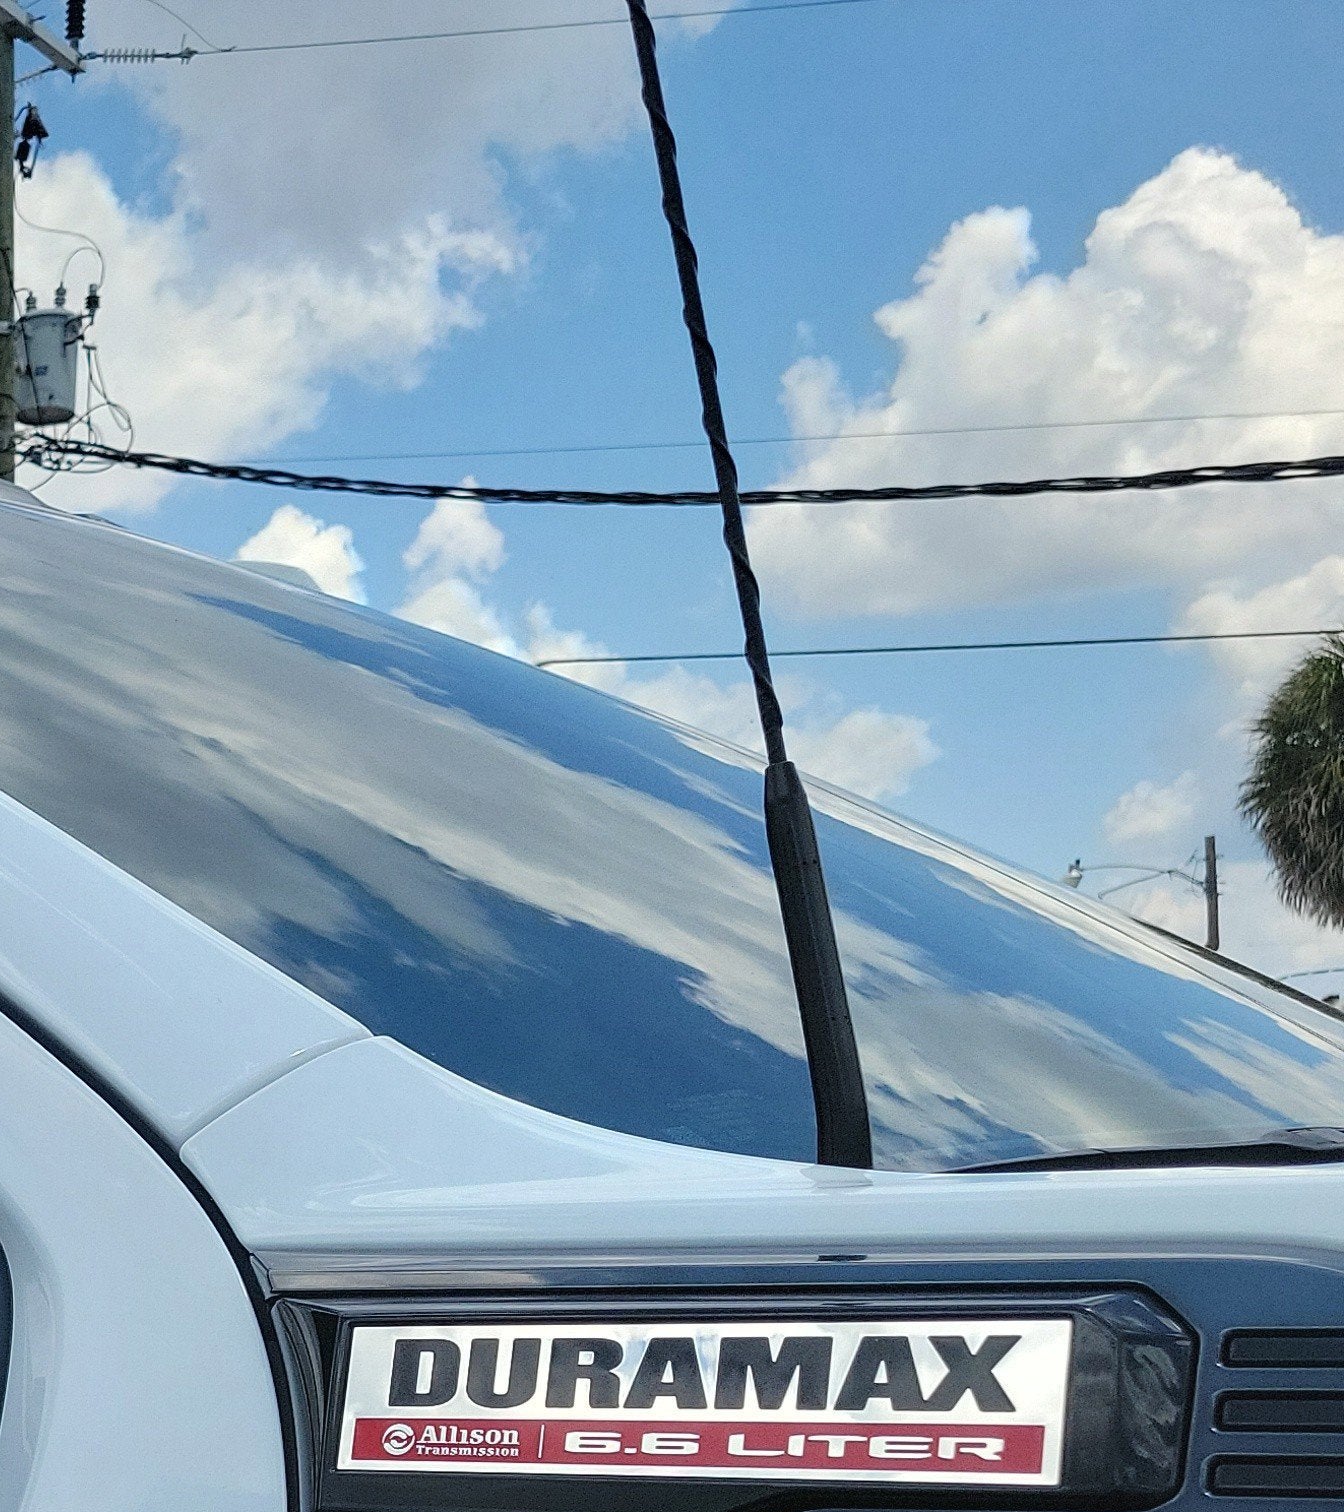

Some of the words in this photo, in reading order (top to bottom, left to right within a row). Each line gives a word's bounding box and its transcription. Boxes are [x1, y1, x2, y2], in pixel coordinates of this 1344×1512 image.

[388, 1335, 1022, 1412] DURAMAX
[416, 1425, 520, 1446] Allison
[564, 1431, 700, 1454] 6.6
[727, 1434, 1005, 1460] LITER
[416, 1445, 520, 1457] Transmission
